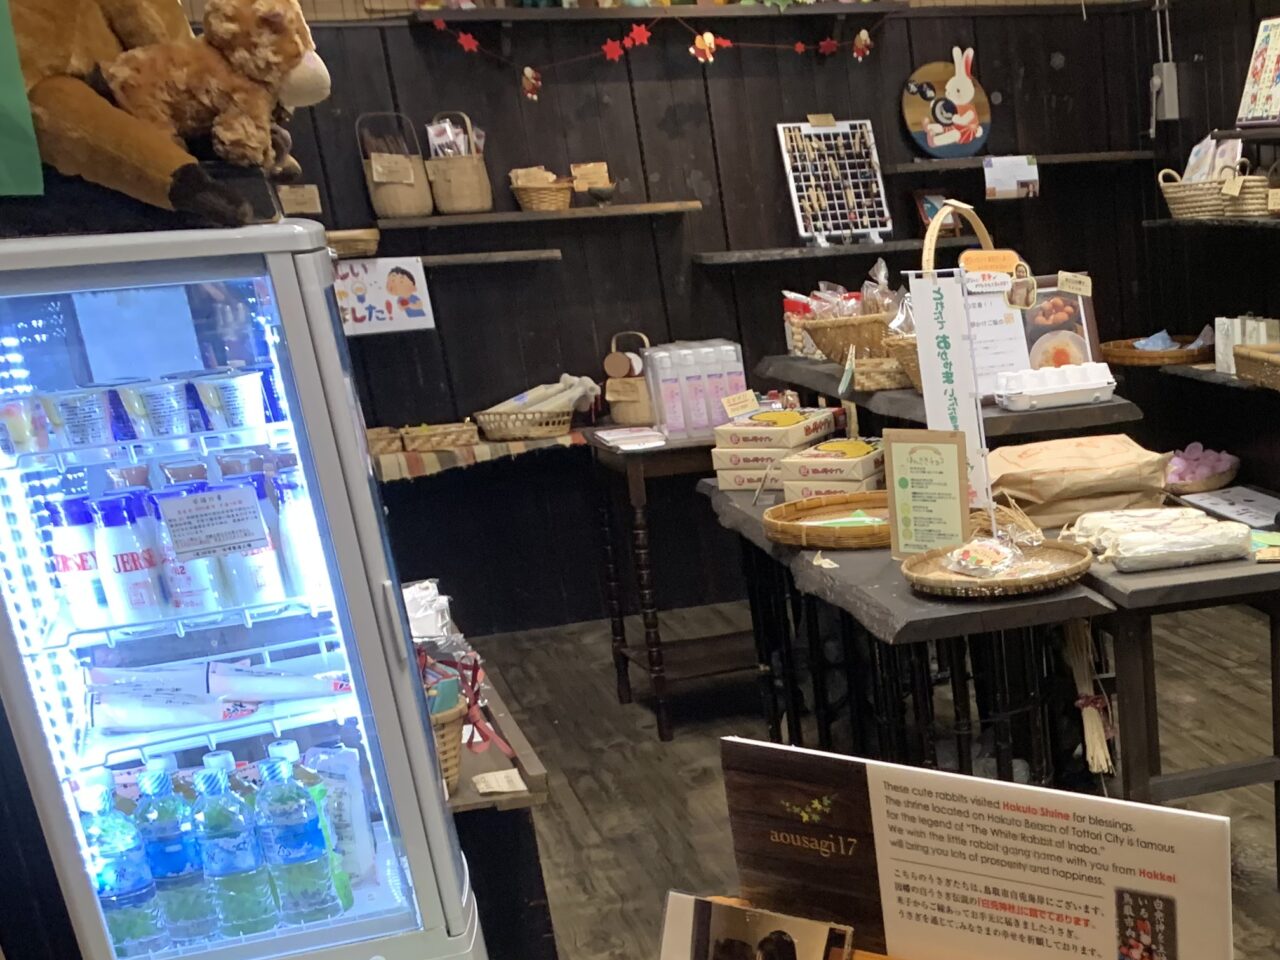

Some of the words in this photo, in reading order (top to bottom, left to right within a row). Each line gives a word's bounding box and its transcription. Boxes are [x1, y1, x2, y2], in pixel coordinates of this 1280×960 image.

[884, 780, 909, 794] These
[911, 786, 933, 798] cute
[935, 787, 968, 804] rabbits
[970, 794, 1001, 810] visited
[1002, 801, 1037, 816] Hakuto
[1040, 807, 1071, 821] Shrine
[1072, 812, 1086, 824] for
[1089, 815, 1136, 833] blessings.
[885, 795, 903, 808] The
[904, 798, 930, 812] shrine
[932, 801, 969, 819] located
[971, 811, 985, 822] on
[987, 813, 1022, 828] Hakuto
[1024, 818, 1056, 833] Beach
[1059, 825, 1070, 836] of
[1071, 827, 1102, 841] Tottori
[1104, 833, 1125, 847] City
[1127, 836, 1135, 847] is
[1136, 837, 1175, 854] famous
[886, 809, 899, 821] for
[901, 811, 916, 824] the
[918, 814, 952, 832] legend
[953, 819, 965, 831] of
[990, 827, 1018, 841] White
[1020, 832, 1053, 847] Rabbit
[1055, 838, 1065, 849] of
[770, 828, 858, 857] aousagi17
[888, 823, 903, 835] We
[906, 826, 926, 838] wish
[928, 828, 945, 842] the
[946, 831, 967, 845] little
[968, 836, 1000, 853] rabbit
[1001, 844, 1031, 860] going
[1065, 855, 1088, 869] with
[1089, 861, 1109, 873] you
[1111, 862, 1136, 876] from
[889, 838, 903, 850] will
[905, 840, 931, 855] bring
[932, 846, 949, 858] you
[950, 847, 967, 861] lots
[968, 850, 979, 862] of
[980, 854, 1027, 873] prosperity
[1029, 863, 1050, 876] and
[1052, 868, 1106, 886] happiness.
